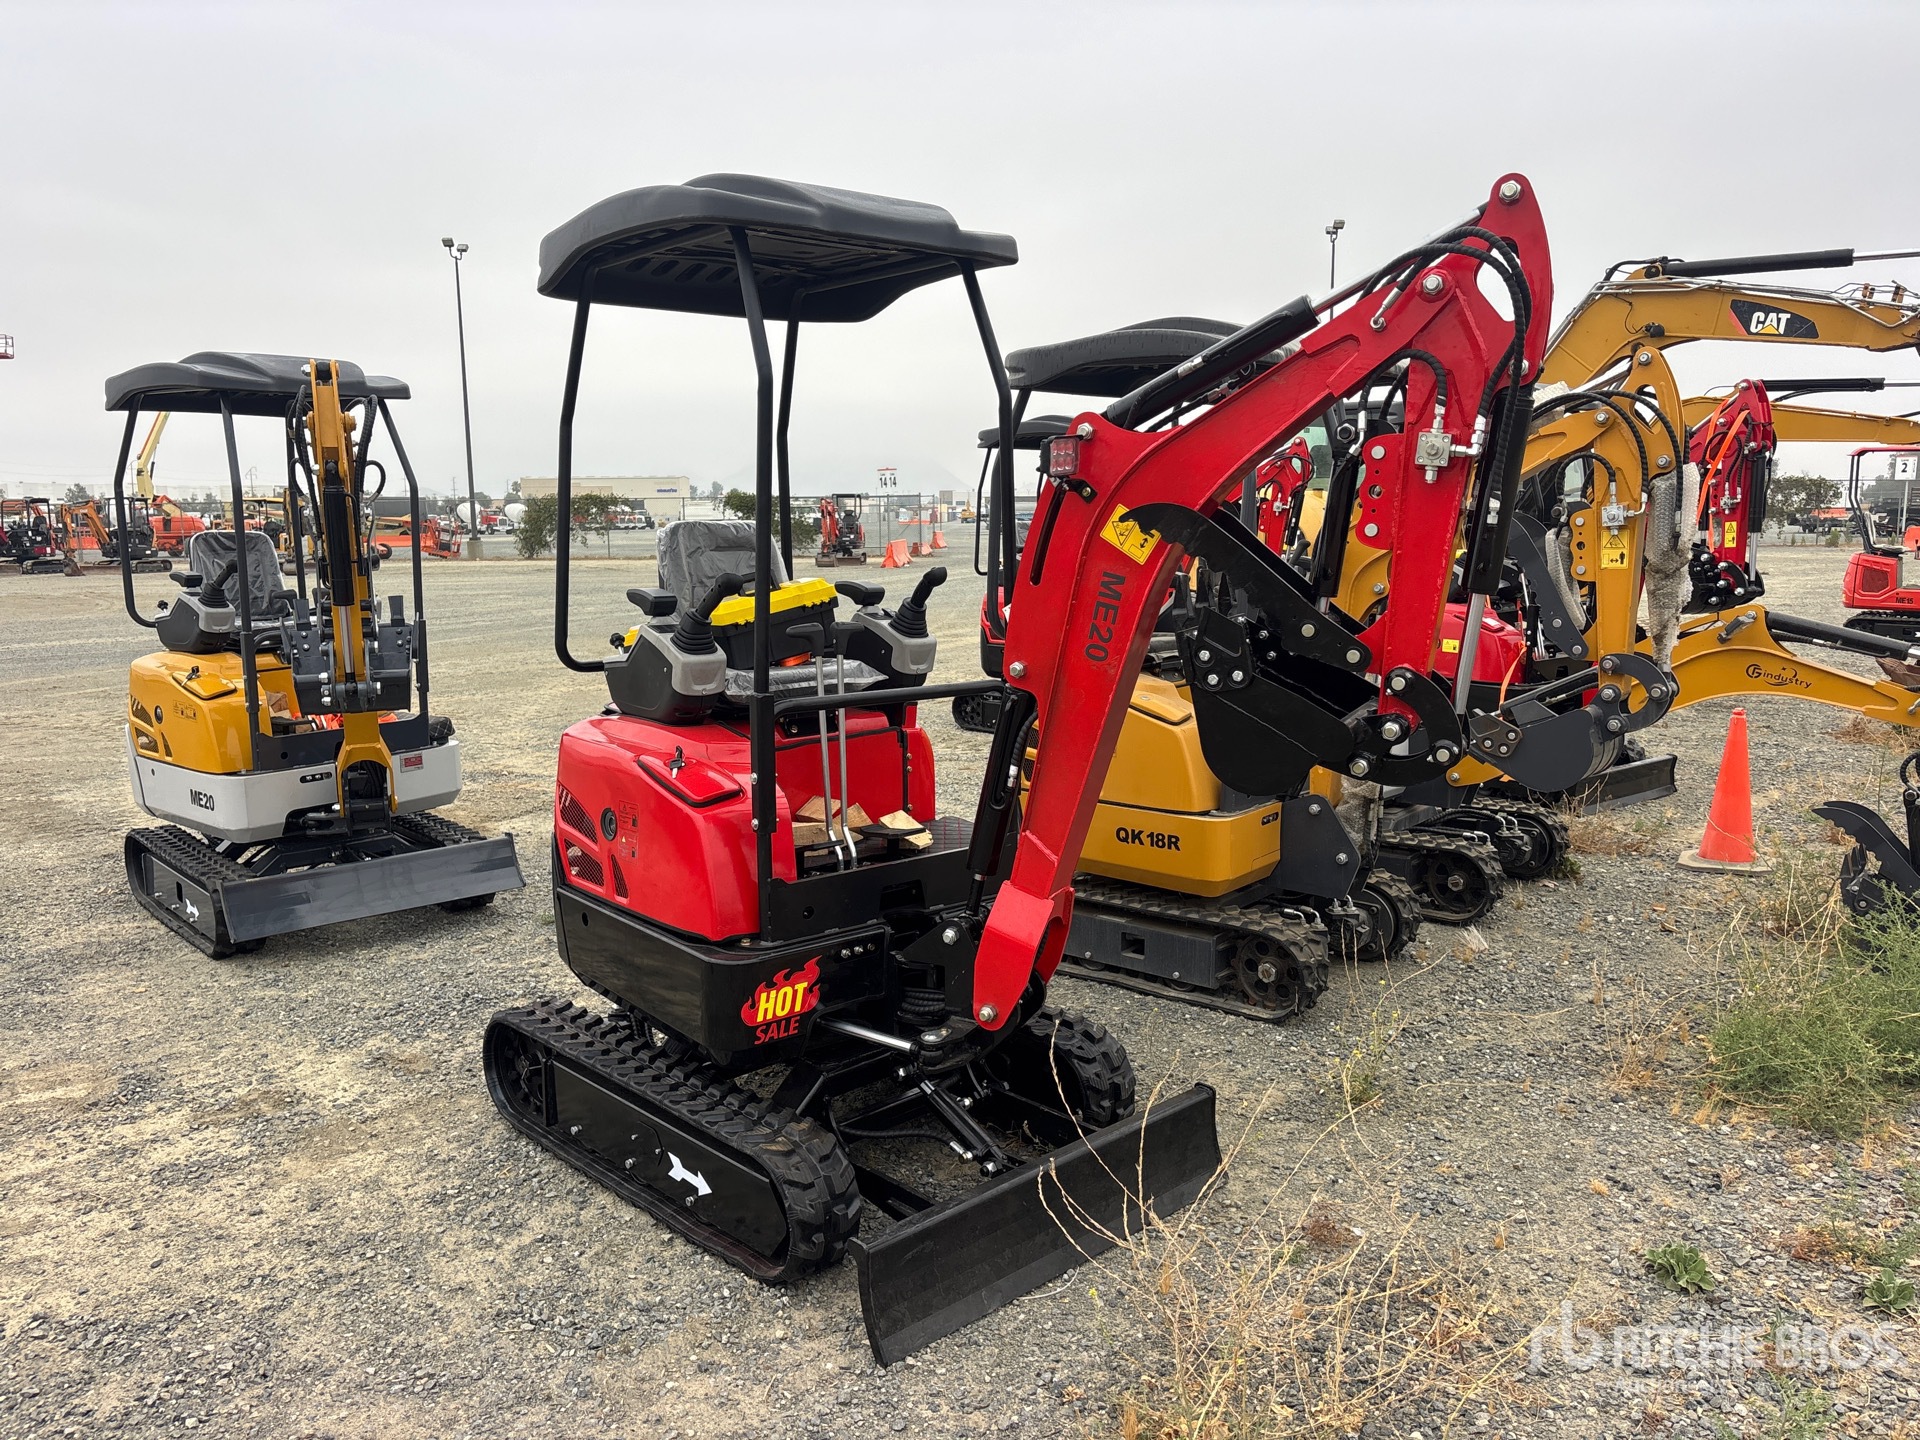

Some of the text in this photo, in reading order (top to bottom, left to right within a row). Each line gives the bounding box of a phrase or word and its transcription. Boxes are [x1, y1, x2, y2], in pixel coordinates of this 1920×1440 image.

[1750, 312, 1791, 334] CAT
[1901, 462, 1908, 473] 2
[1085, 571, 1126, 662] ME20
[190, 788, 215, 811] ME20
[756, 982, 808, 1022] HOT
[754, 1016, 800, 1045] SALE
